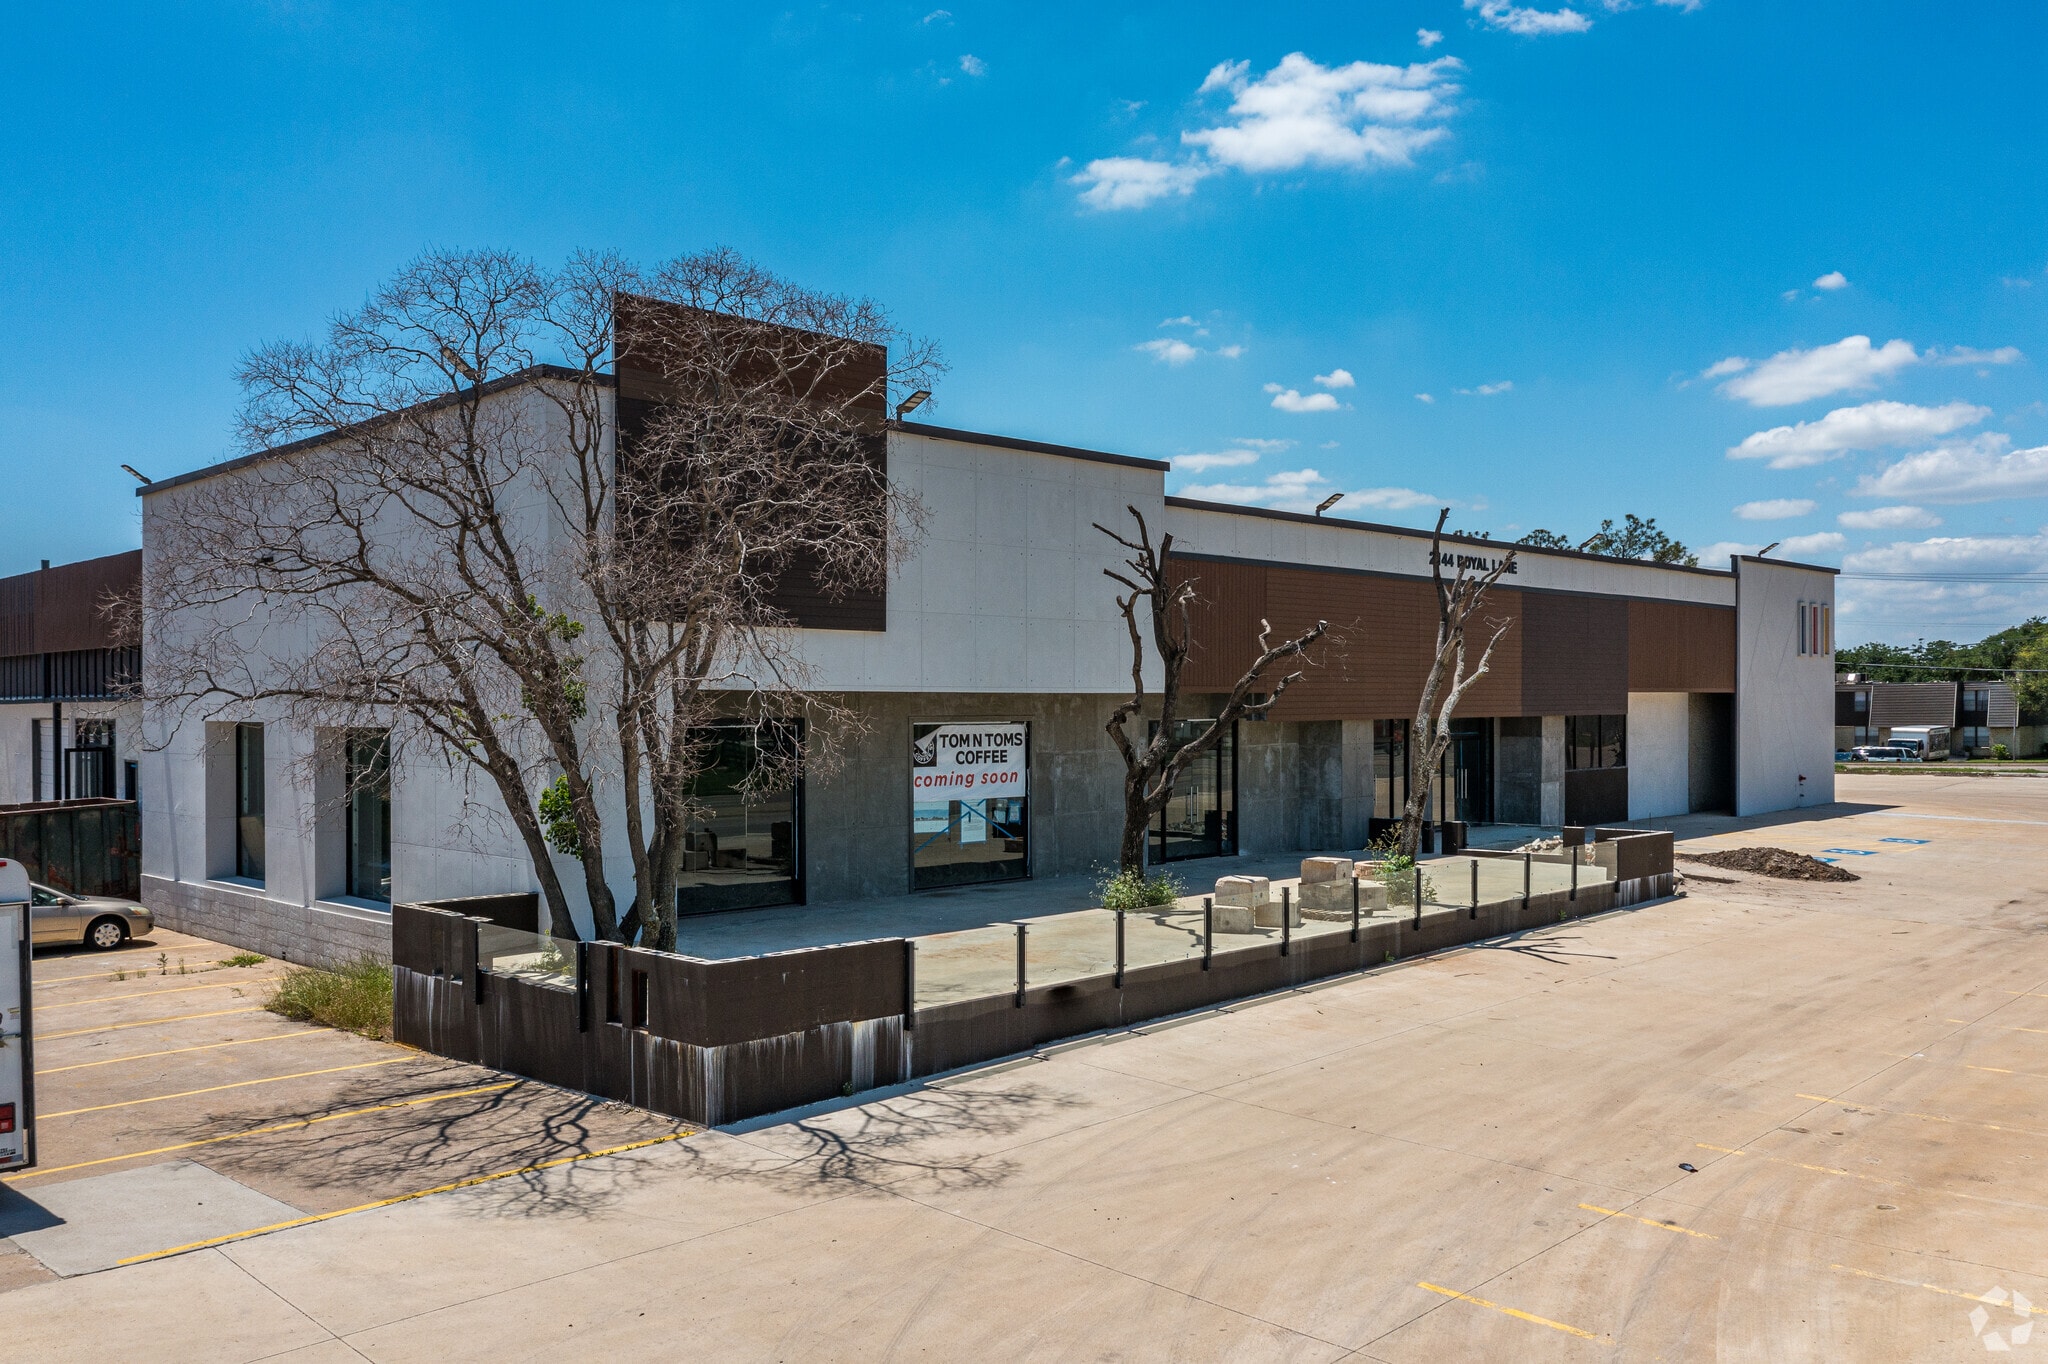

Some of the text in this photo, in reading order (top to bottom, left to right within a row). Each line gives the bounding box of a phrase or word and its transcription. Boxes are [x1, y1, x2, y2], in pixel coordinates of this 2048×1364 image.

[1429, 551, 1454, 567] 244
[939, 733, 970, 748] TOM
[972, 733, 982, 747] N
[985, 732, 1023, 747] TOMS
[955, 750, 1008, 765] COFFEE
[914, 771, 1019, 788] coming soon
